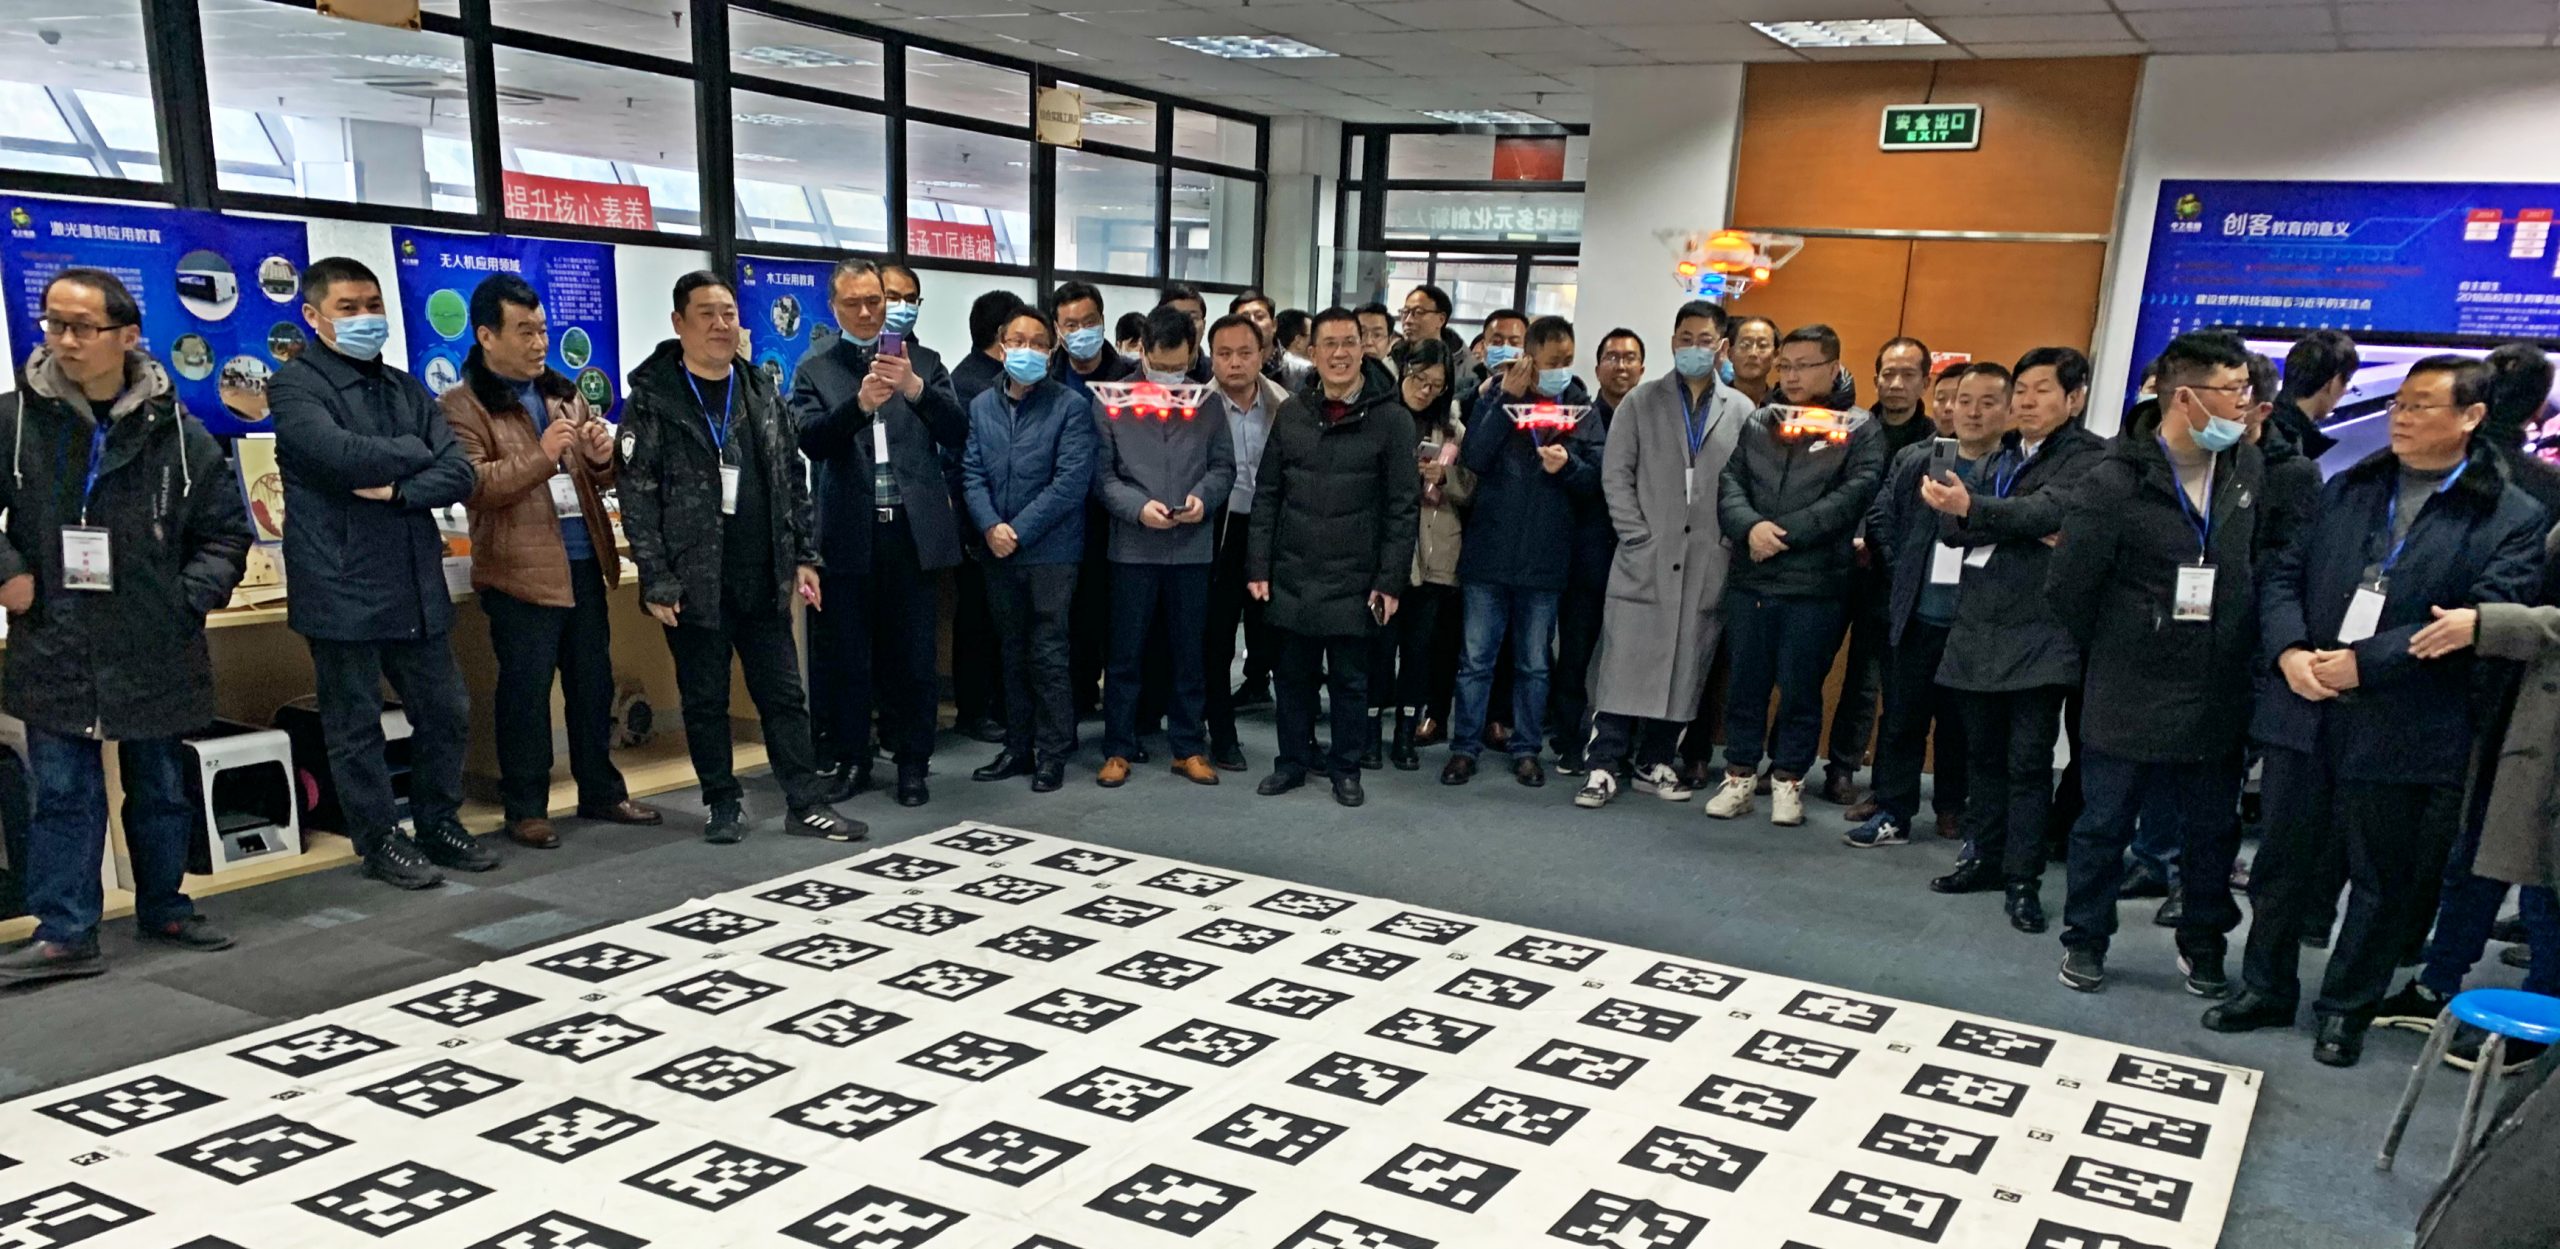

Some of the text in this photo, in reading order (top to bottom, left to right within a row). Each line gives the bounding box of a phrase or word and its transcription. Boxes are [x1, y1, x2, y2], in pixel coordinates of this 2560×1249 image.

[1895, 112, 1965, 131] 安全出口
[1906, 131, 1950, 142] EXIT
[506, 184, 648, 230] 提升核心素养
[50, 220, 162, 244] 激光雕刻应用教育
[2222, 212, 2351, 238] 创客教育的意义
[440, 252, 521, 273] 无人机应用领域
[766, 271, 815, 288] 木工应用教育
